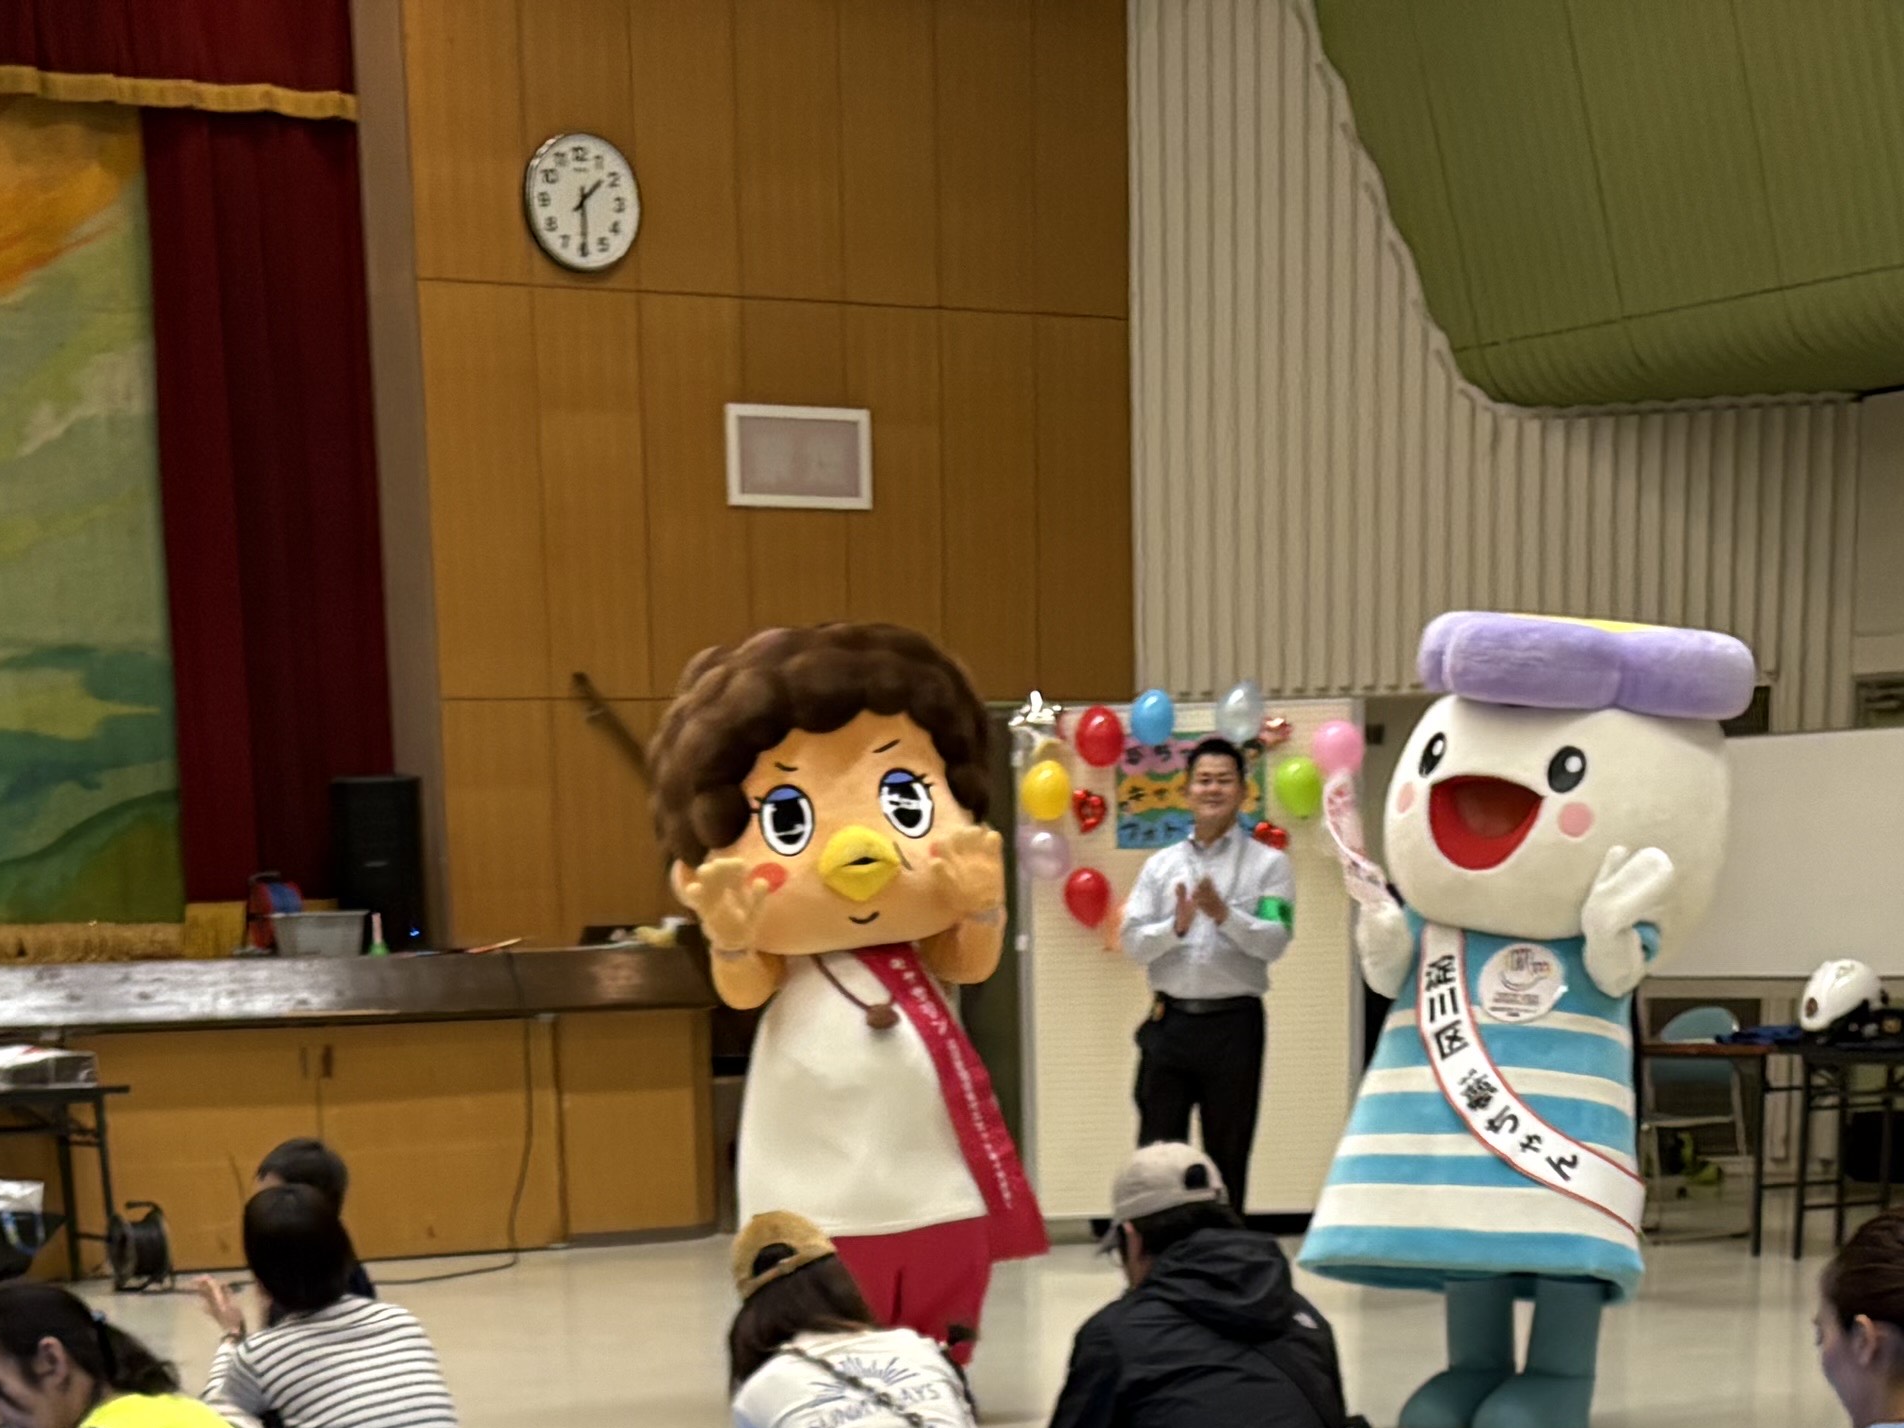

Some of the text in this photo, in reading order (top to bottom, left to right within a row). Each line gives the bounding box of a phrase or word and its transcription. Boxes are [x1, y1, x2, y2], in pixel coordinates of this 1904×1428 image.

[572, 146, 589, 161] 12
[608, 171, 621, 188] 2
[614, 196, 626, 213] 3
[597, 236, 610, 253] 5
[1425, 954, 1470, 1060] 淀川区
